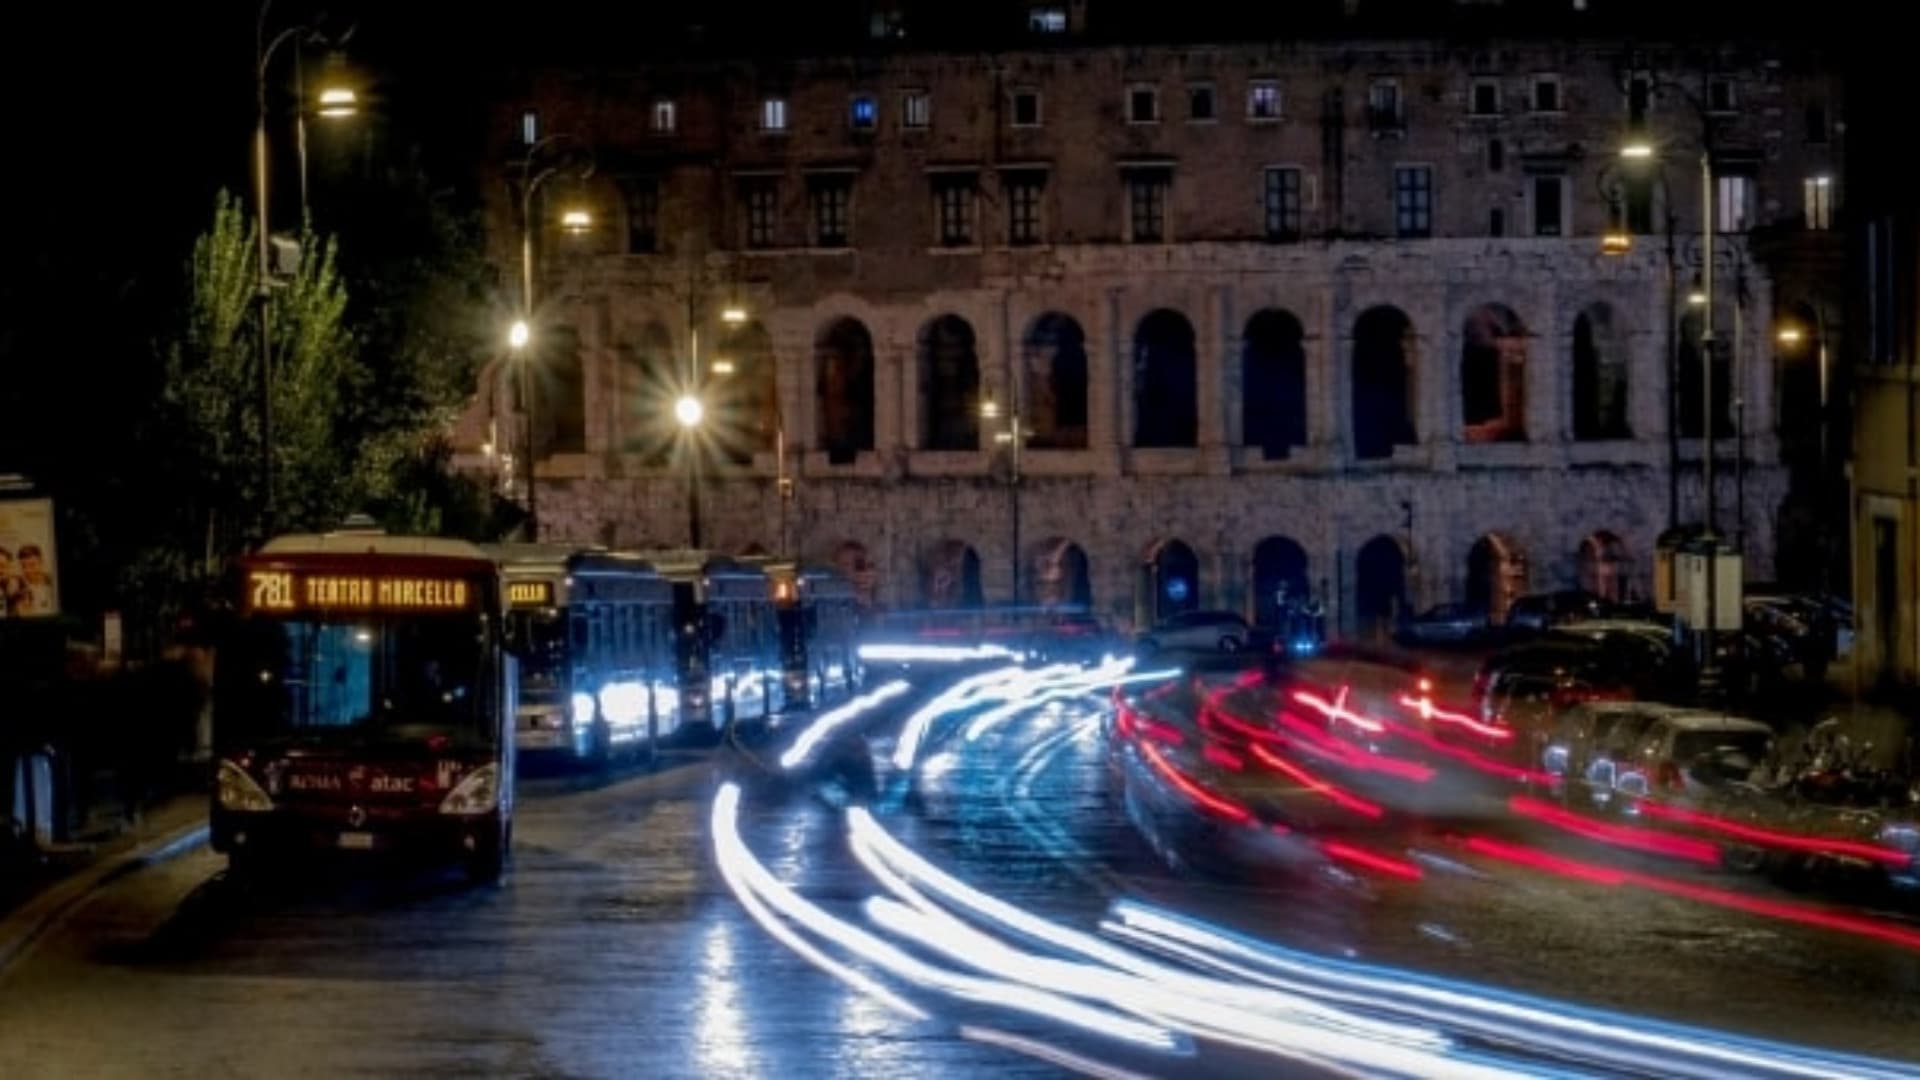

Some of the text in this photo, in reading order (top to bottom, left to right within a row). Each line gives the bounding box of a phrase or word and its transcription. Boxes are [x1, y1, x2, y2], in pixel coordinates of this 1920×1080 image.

[251, 571, 466, 608] 781 TEATRO MARCELLO
[370, 774, 414, 792] atac
